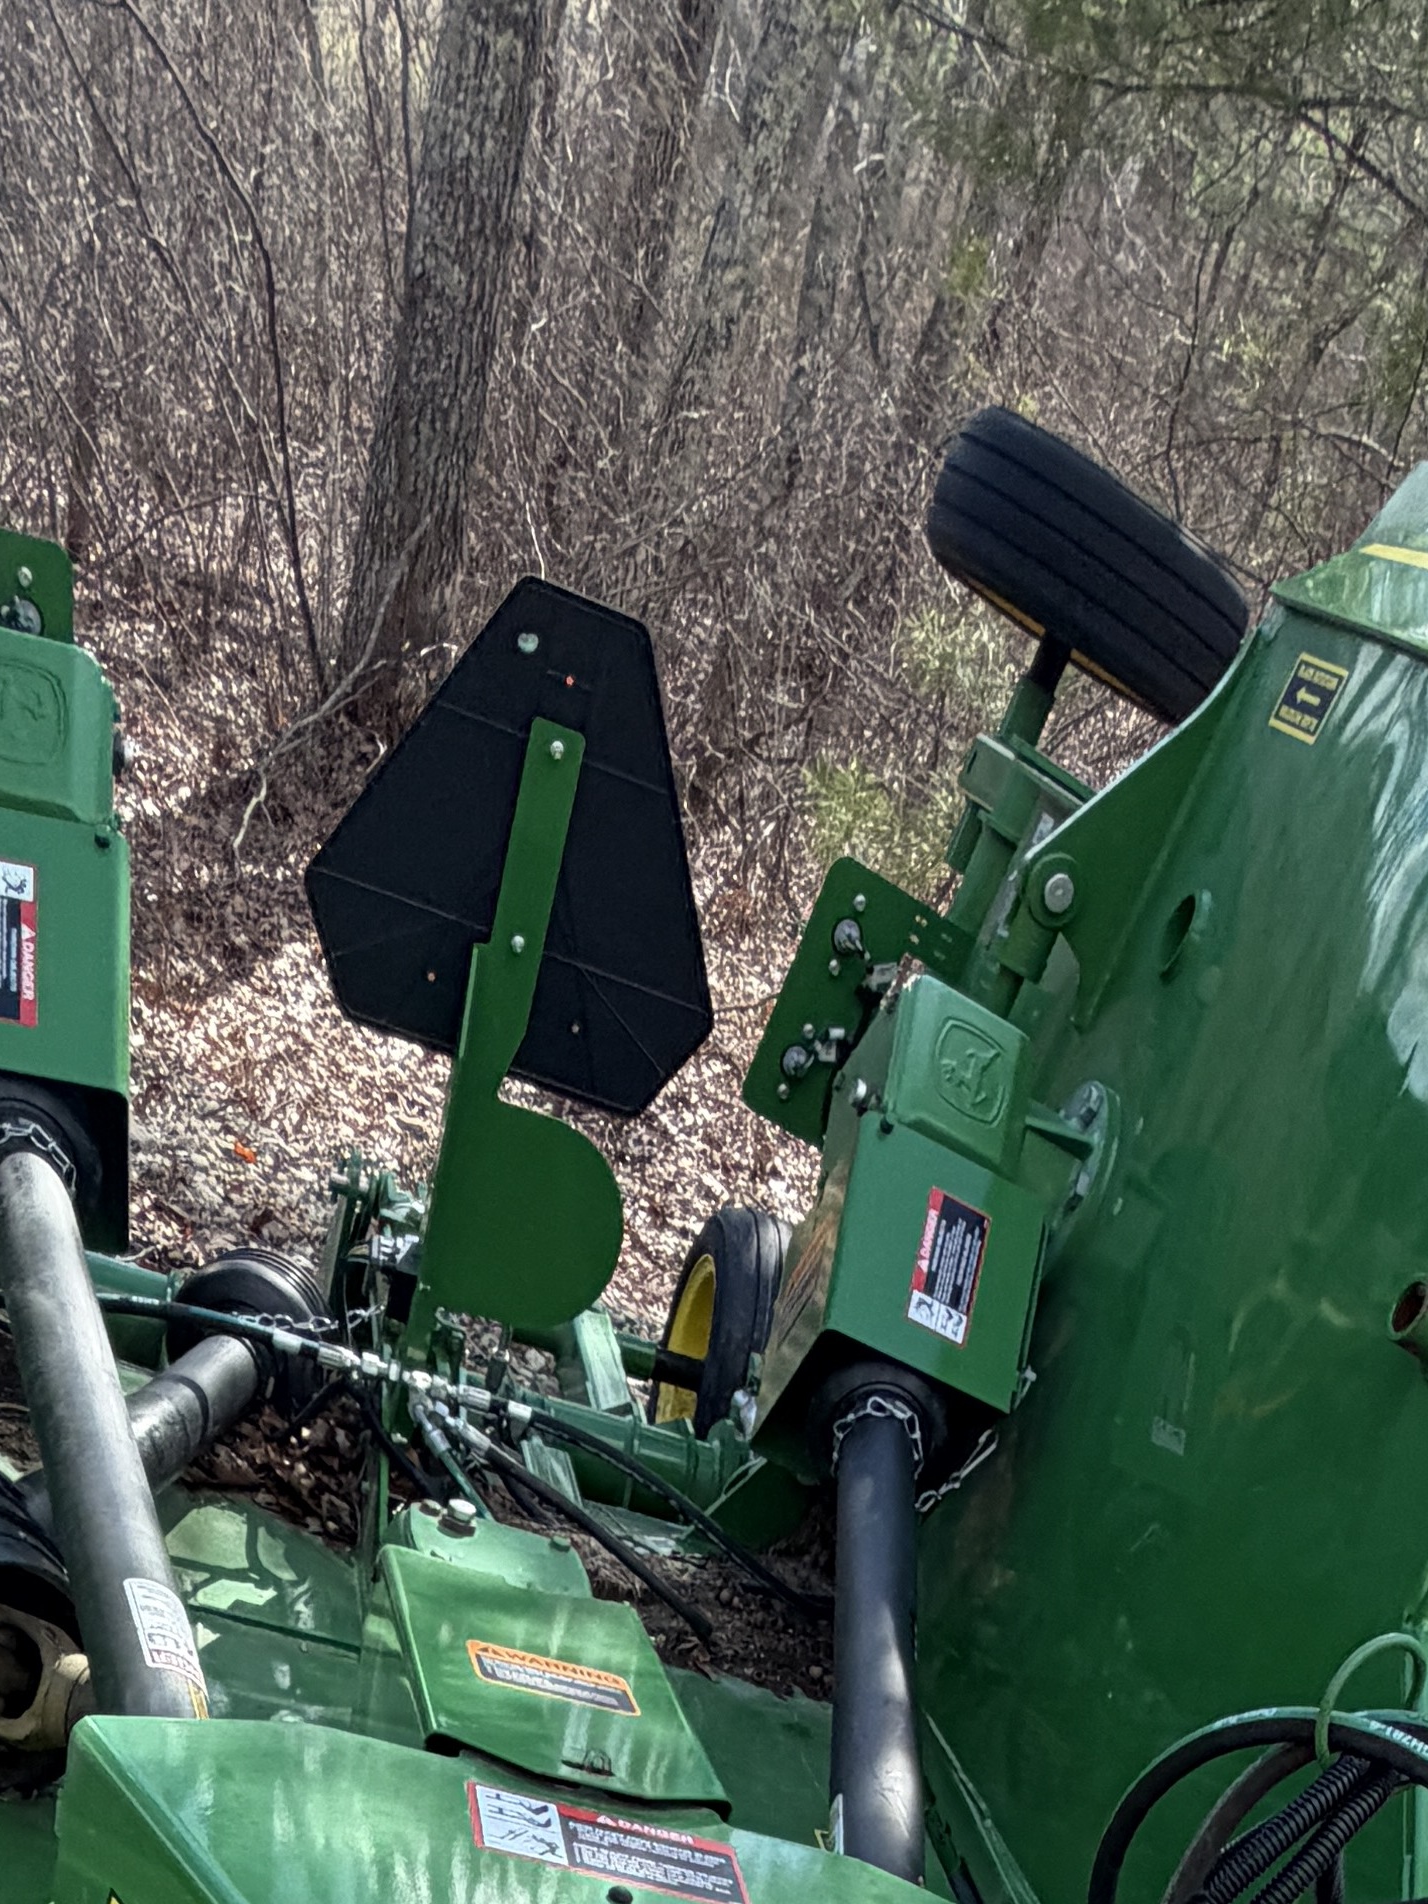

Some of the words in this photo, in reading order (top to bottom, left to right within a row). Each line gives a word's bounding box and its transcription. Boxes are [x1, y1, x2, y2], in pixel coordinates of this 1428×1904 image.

[22, 942, 35, 1000] DANGER
[920, 1208, 939, 1258] DANGER
[617, 1819, 694, 1845] DANGER
